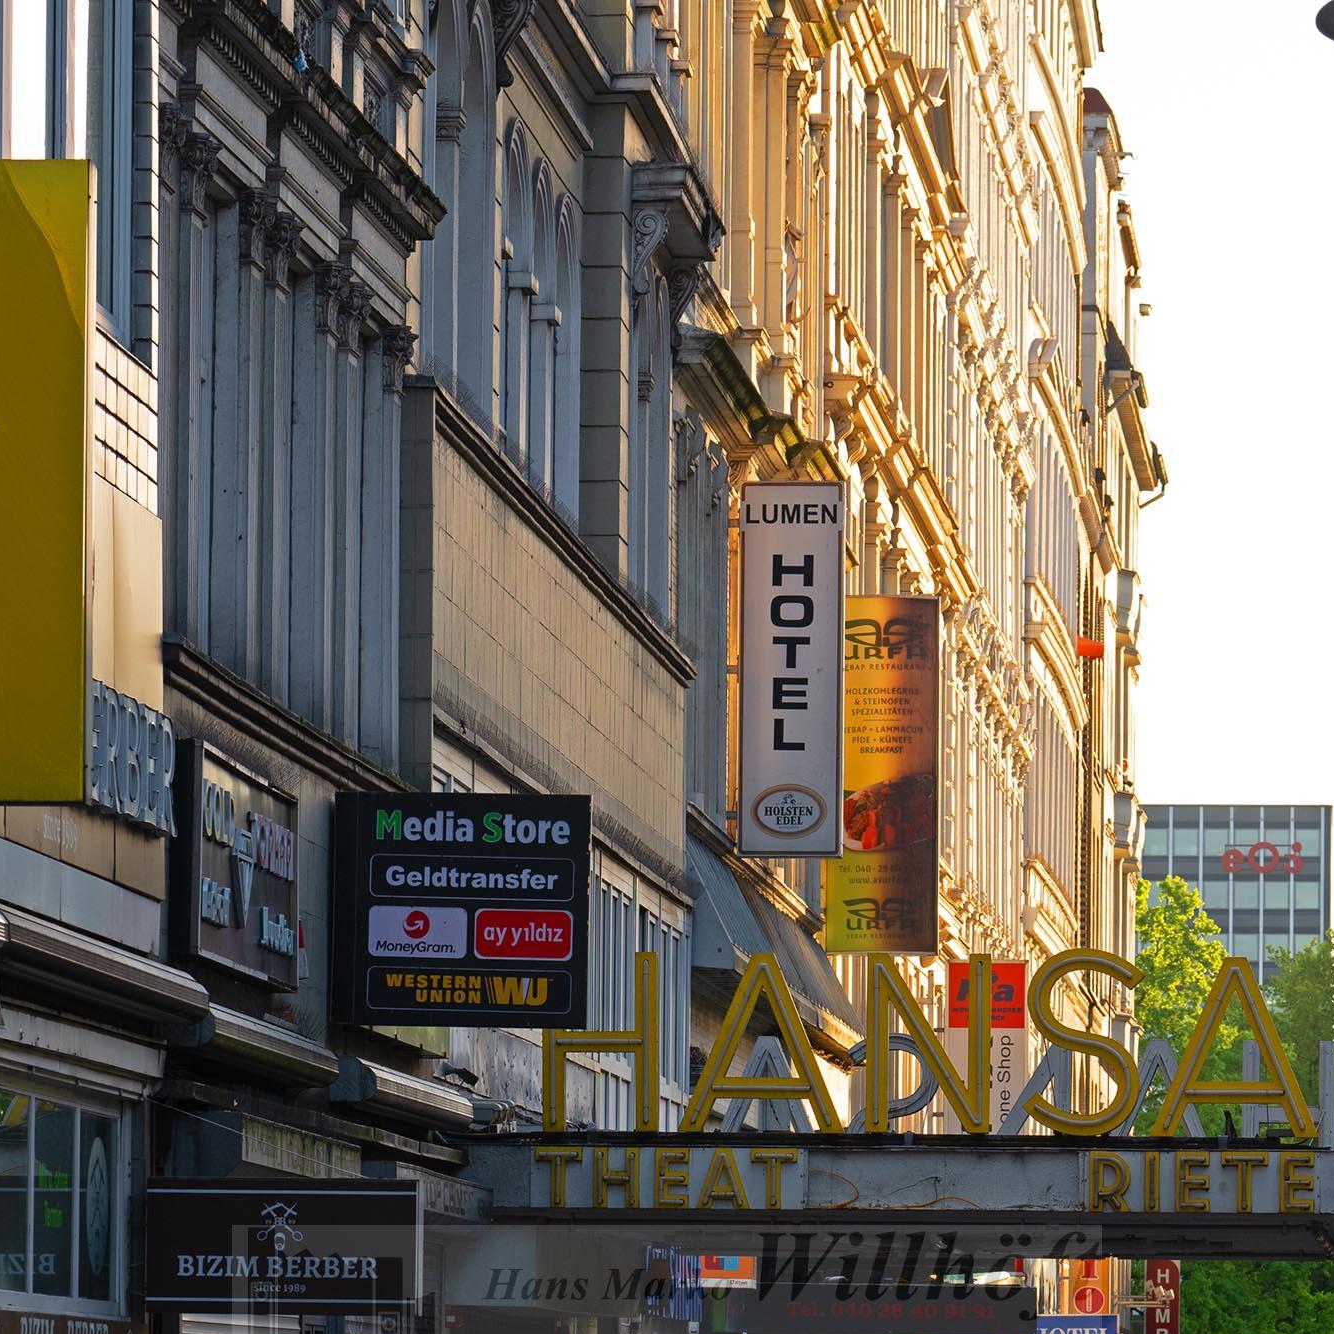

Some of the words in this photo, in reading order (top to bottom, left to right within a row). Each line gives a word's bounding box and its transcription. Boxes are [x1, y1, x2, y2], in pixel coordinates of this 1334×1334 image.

[745, 503, 838, 525] LUMEN
[770, 553, 815, 752] HOTEL
[844, 663, 866, 672] EBAP
[764, 805, 814, 818] HOLSTEN
[775, 814, 804, 826] EDEL
[375, 809, 474, 842] Media
[482, 811, 571, 845] Store
[385, 865, 559, 890] Geldtransfer
[483, 926, 510, 946] ay
[385, 973, 482, 989] WESTERN
[494, 976, 549, 1007] WU
[415, 989, 482, 1005] UNION
[541, 947, 1320, 1139] HANSA
[997, 1034, 1014, 1084] Shop
[534, 1146, 798, 1211] THEAT
[1088, 1149, 1316, 1214] RIETE
[176, 1254, 261, 1278] BIZIM
[267, 1255, 378, 1280] BERBER
[253, 1281, 282, 1294] since
[283, 1282, 307, 1294] 1989
